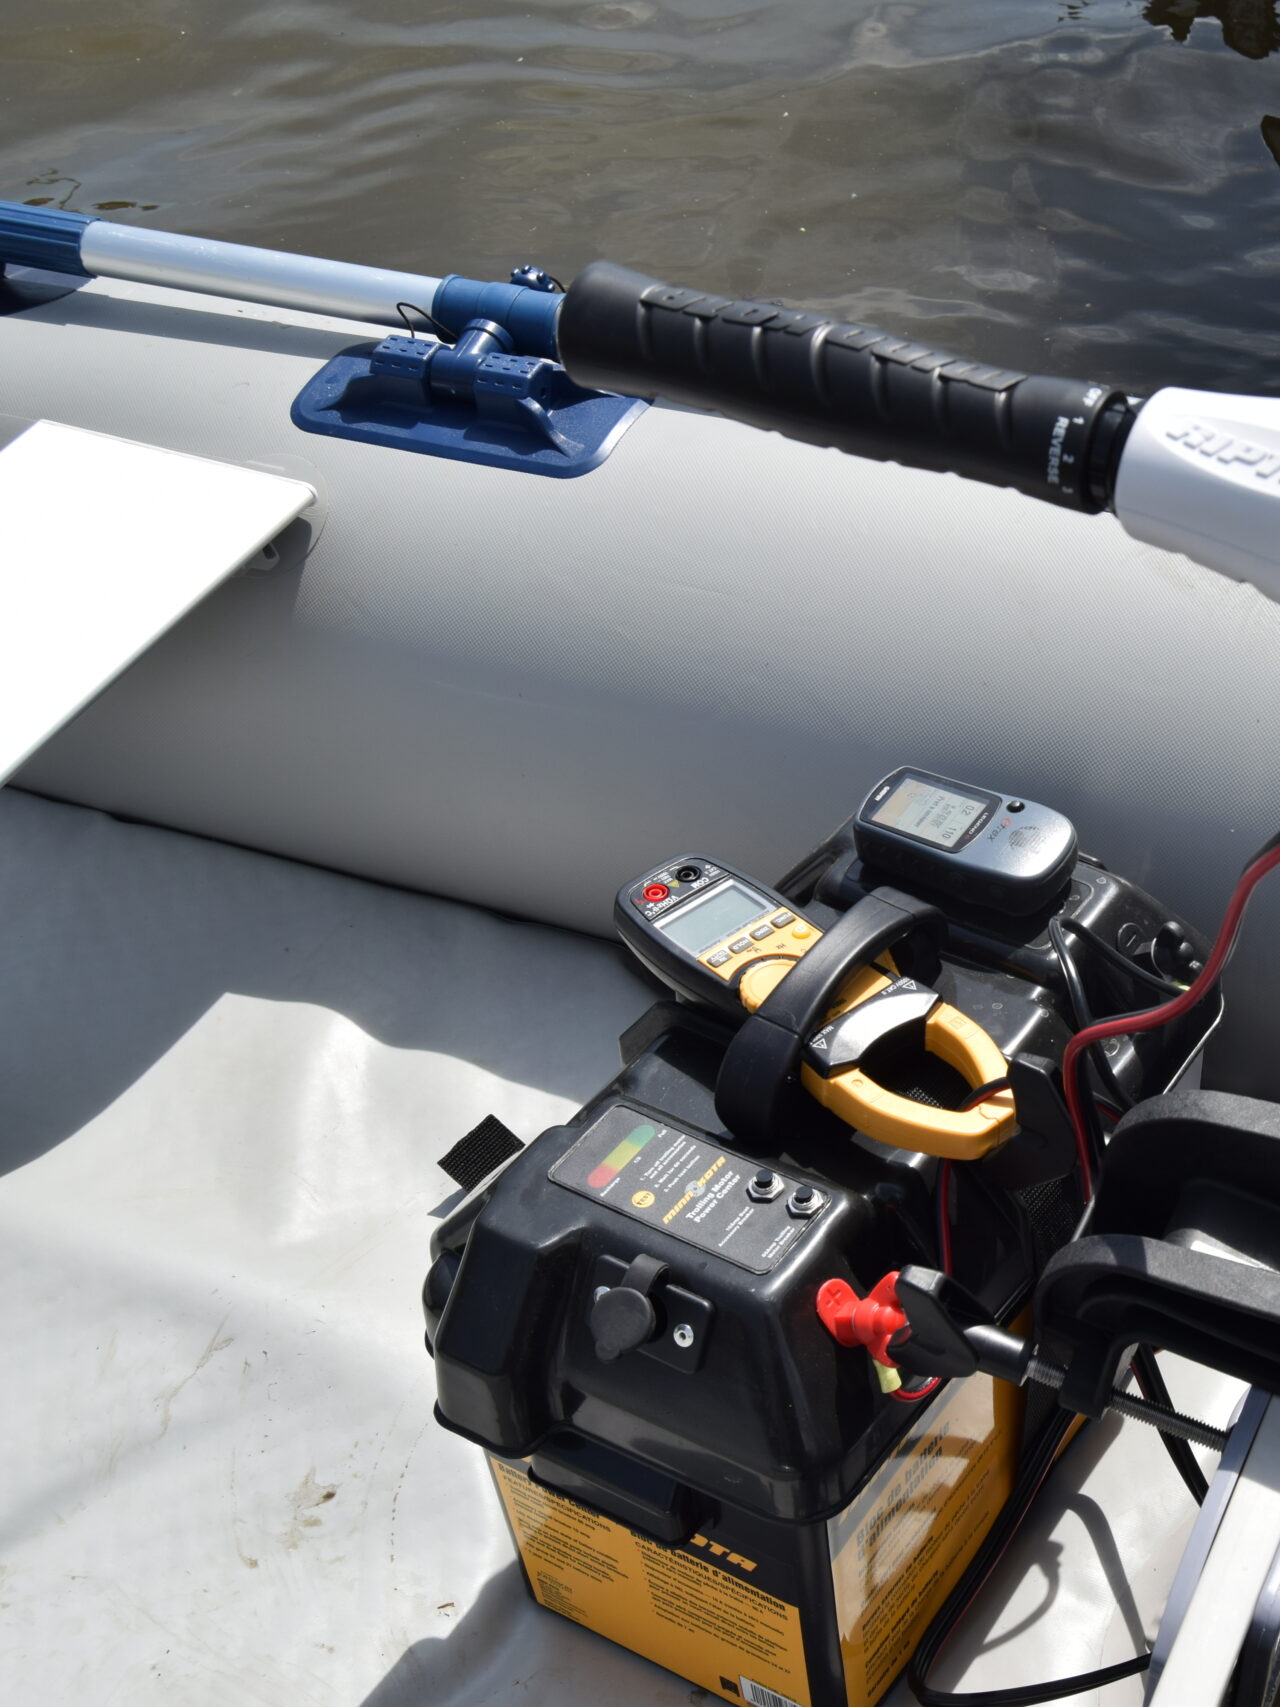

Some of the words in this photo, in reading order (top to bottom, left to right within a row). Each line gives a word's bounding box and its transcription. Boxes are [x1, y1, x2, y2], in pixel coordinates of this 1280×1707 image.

[1072, 417, 1084, 425] 1
[1047, 415, 1070, 484] REVERSE
[1062, 454, 1074, 464] 2
[690, 877, 710, 889] COM
[685, 1191, 715, 1220] Trolling
[711, 1169, 735, 1192] Motor
[693, 1198, 720, 1223] Power
[714, 1173, 742, 1199] Center
[690, 1533, 758, 1572] OTA
[670, 1549, 710, 1573] batterie
[713, 1566, 786, 1611] d'alimentation
